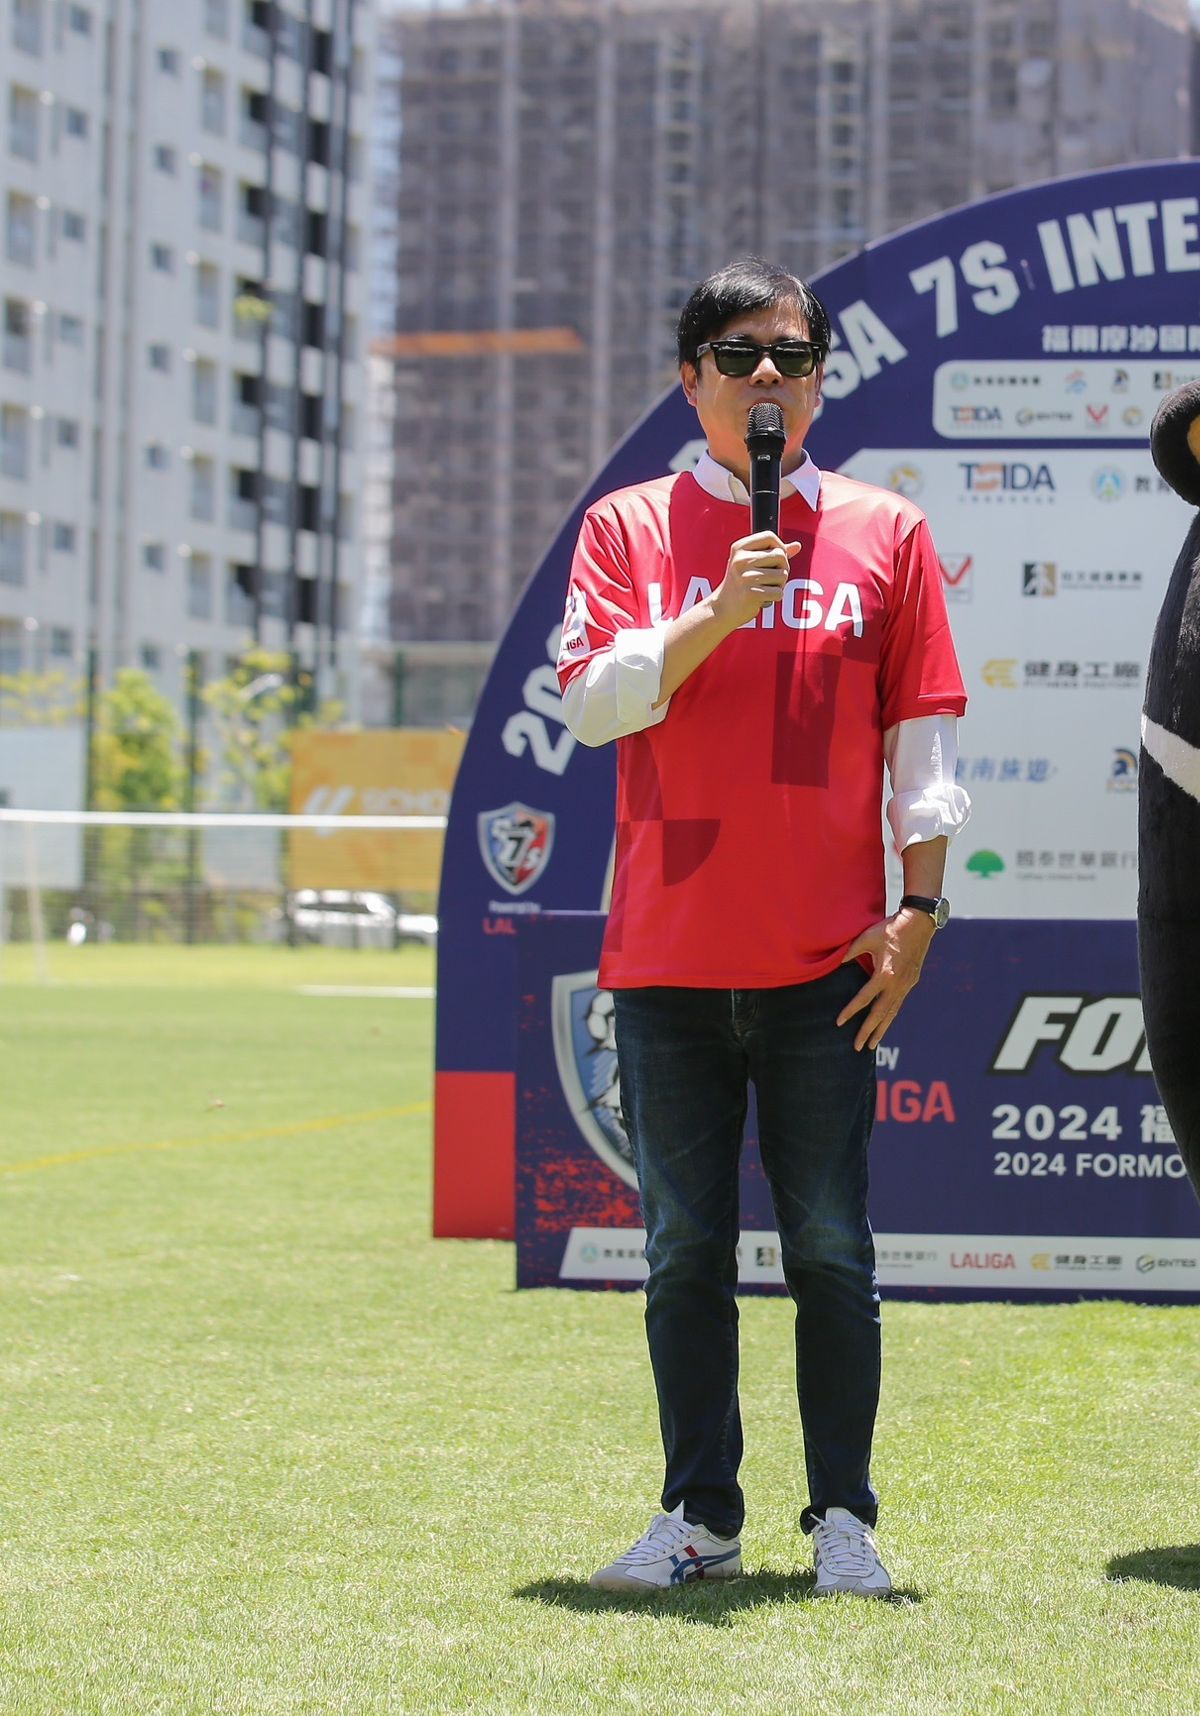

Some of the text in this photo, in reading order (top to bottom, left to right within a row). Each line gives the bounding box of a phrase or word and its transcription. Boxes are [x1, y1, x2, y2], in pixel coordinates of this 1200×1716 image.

[909, 241, 1020, 338] 7S
[648, 576, 864, 638] LAIGA
[993, 996, 1153, 1071] FO
[992, 1104, 1122, 1141] 2024
[993, 1152, 1067, 1176] 2024
[951, 1253, 1015, 1269] LALIGA
